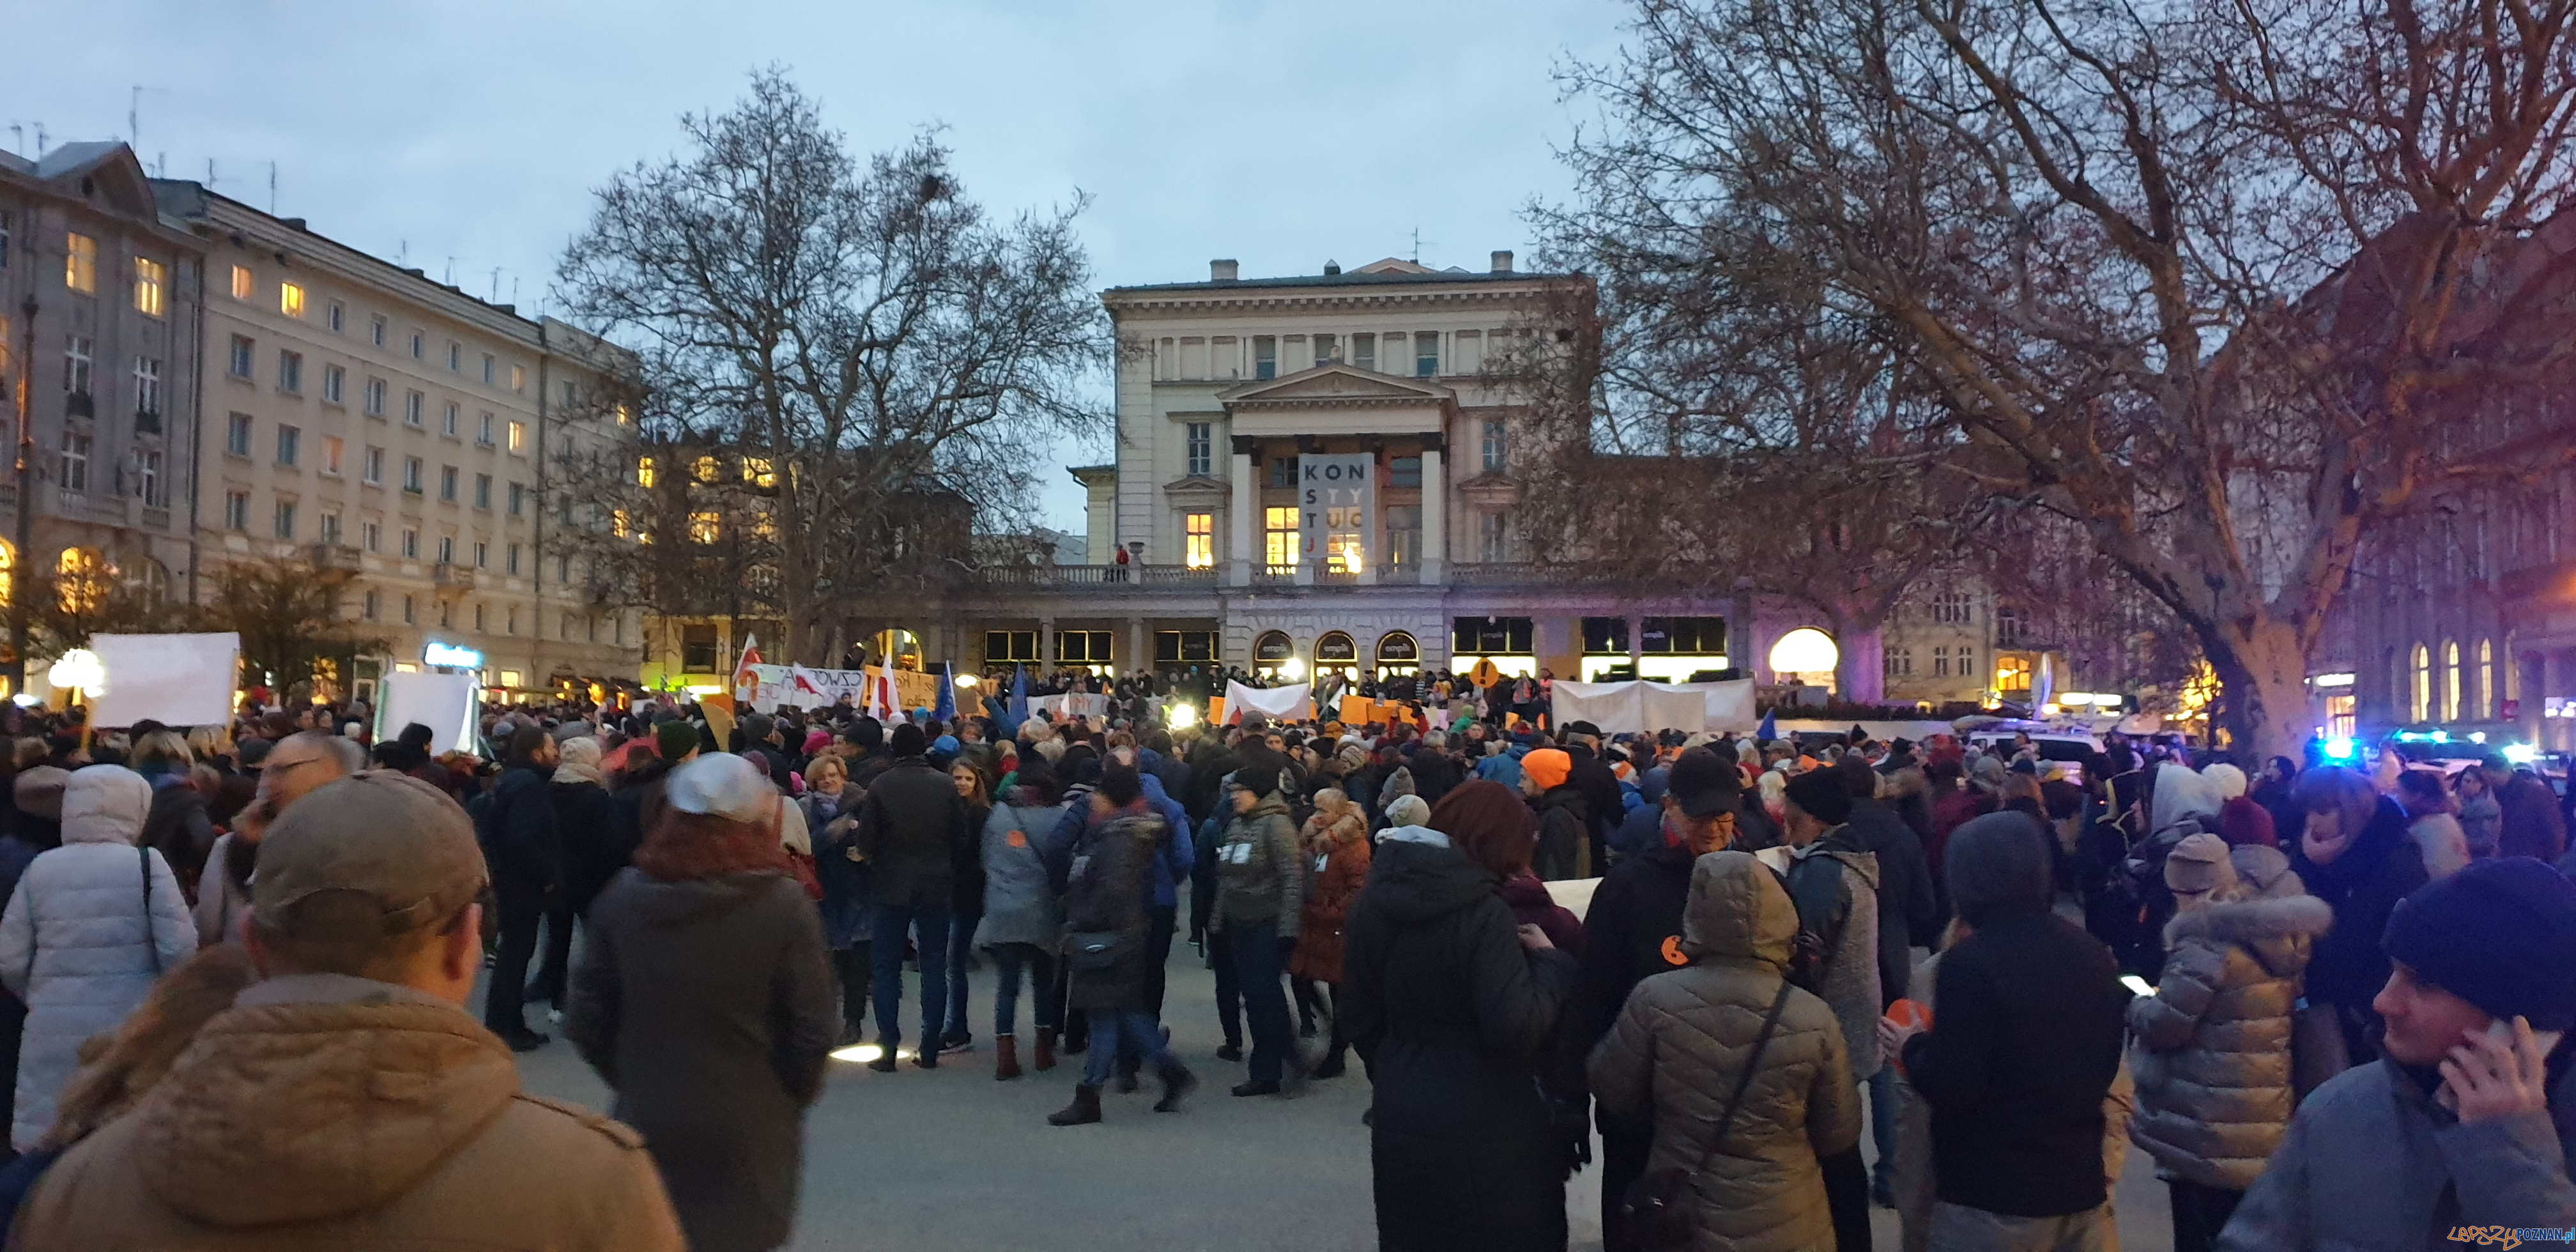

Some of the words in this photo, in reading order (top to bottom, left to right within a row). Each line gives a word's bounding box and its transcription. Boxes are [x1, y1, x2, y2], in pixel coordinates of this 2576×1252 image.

[1305, 464, 1365, 480] KON
[1305, 488, 1363, 505] STY
[1323, 643, 1349, 653] empik
[1384, 643, 1411, 653] empik
